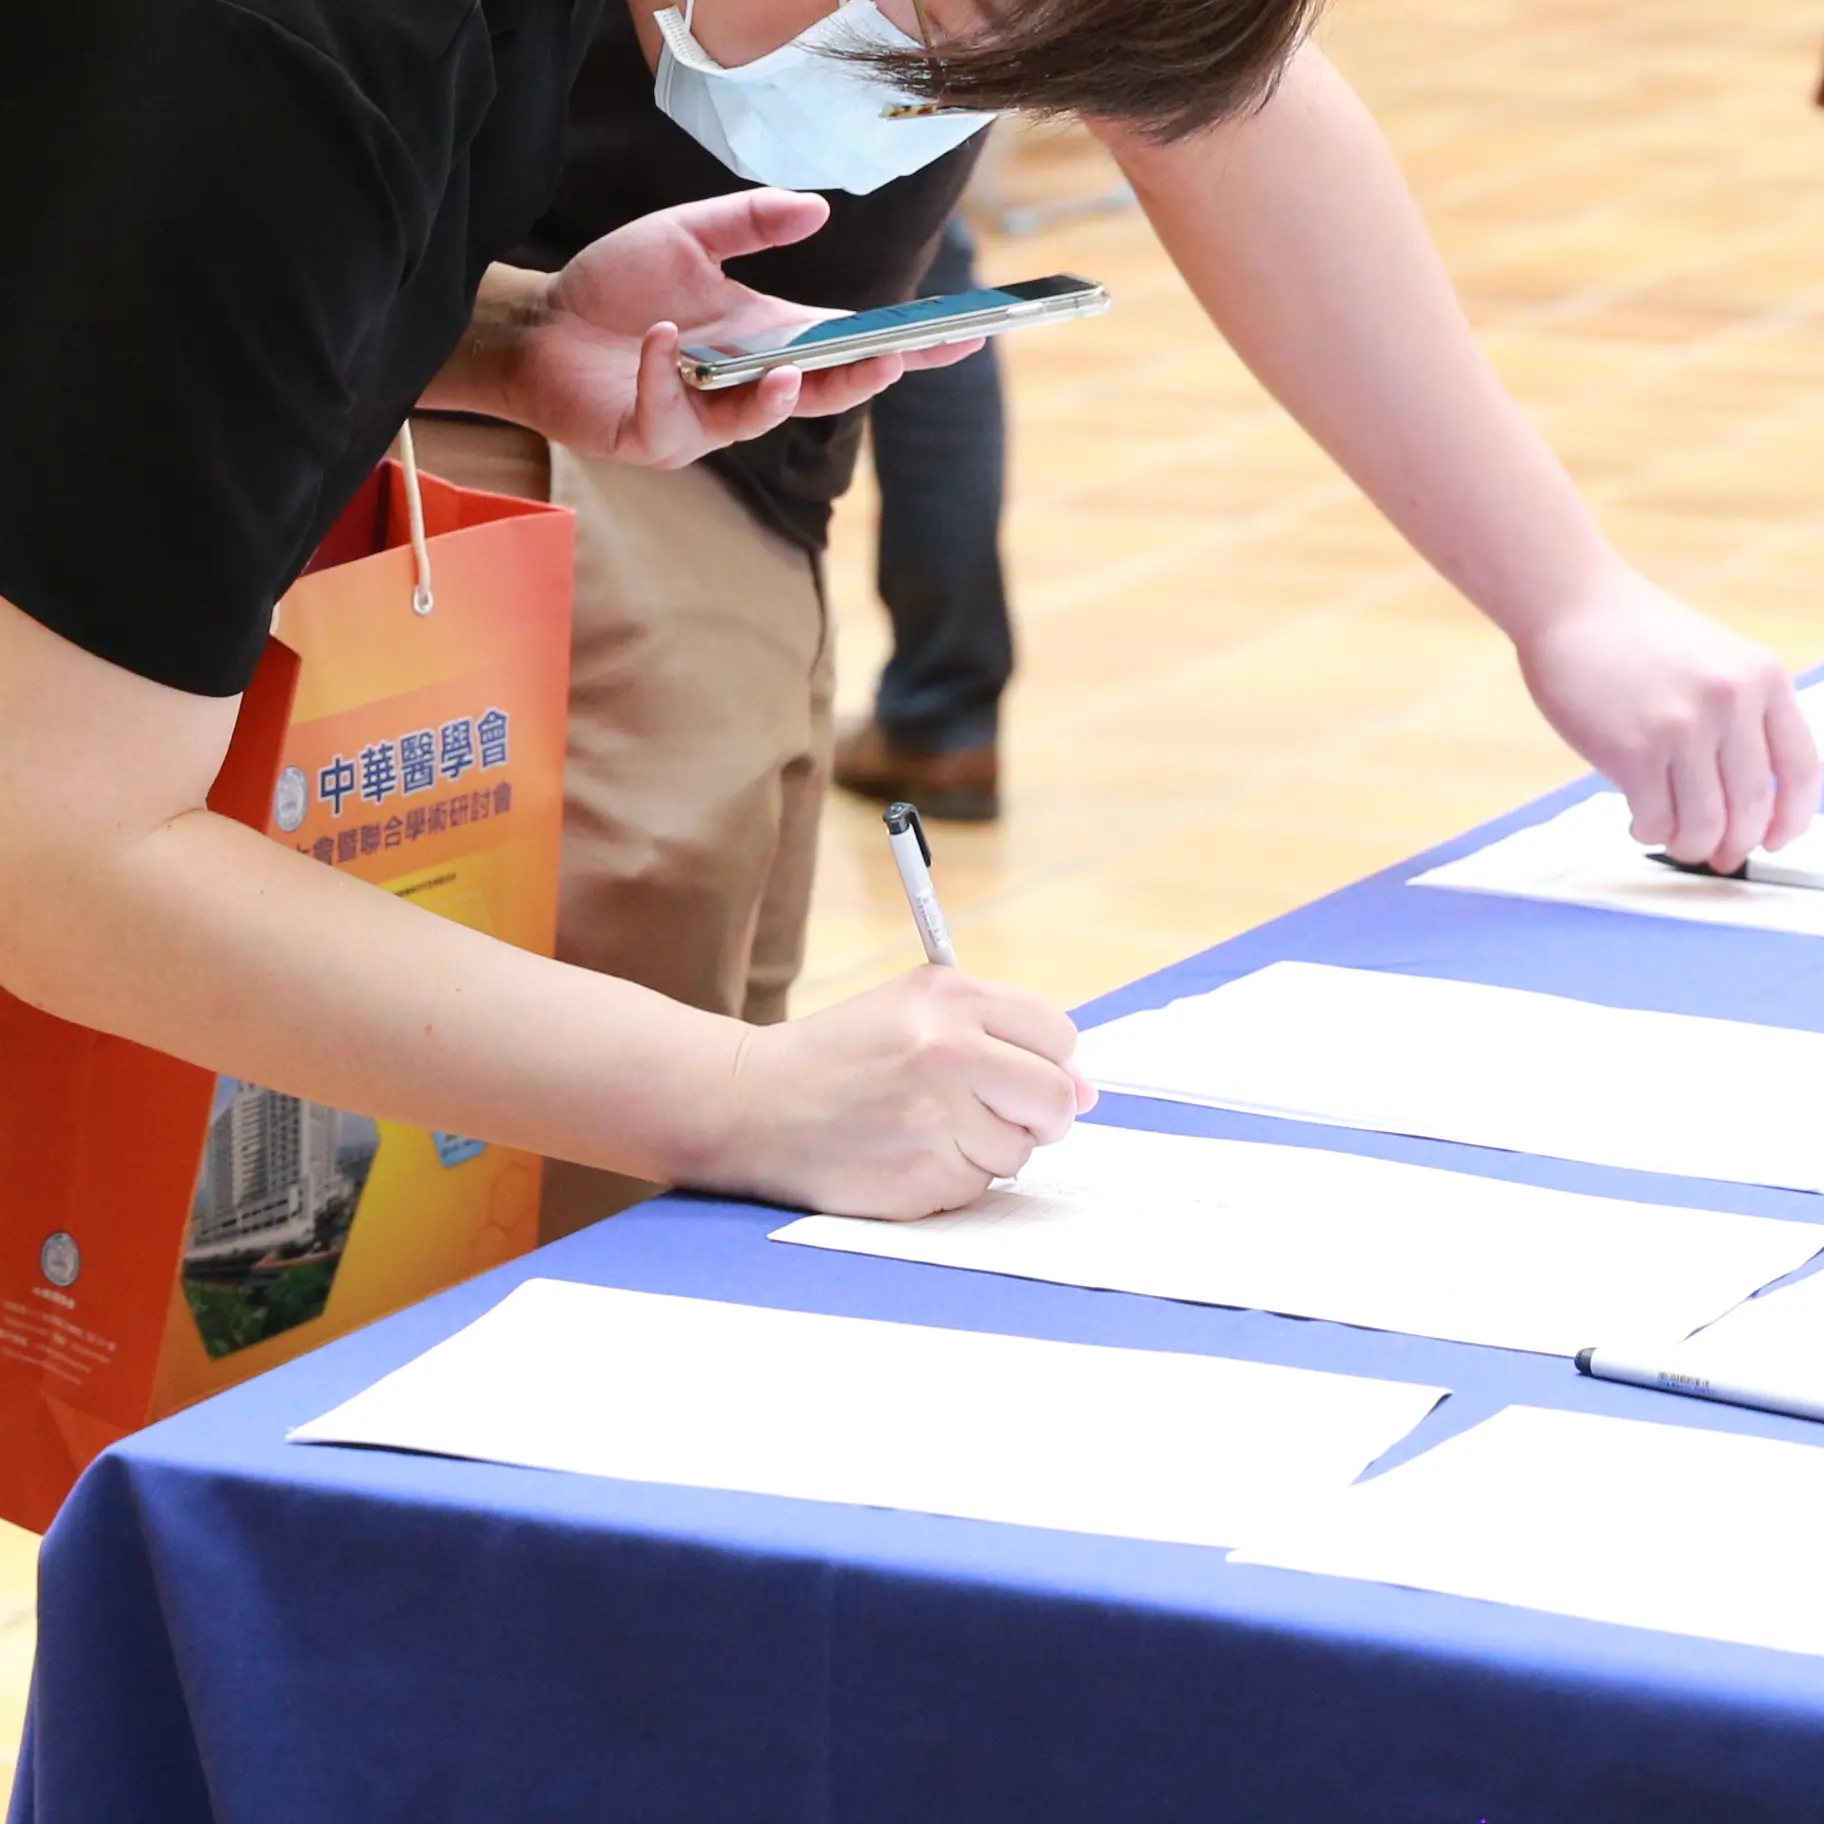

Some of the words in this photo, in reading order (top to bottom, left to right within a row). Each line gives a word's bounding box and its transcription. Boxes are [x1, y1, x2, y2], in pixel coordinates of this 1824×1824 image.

[319, 707, 509, 816] 中華醫學會
